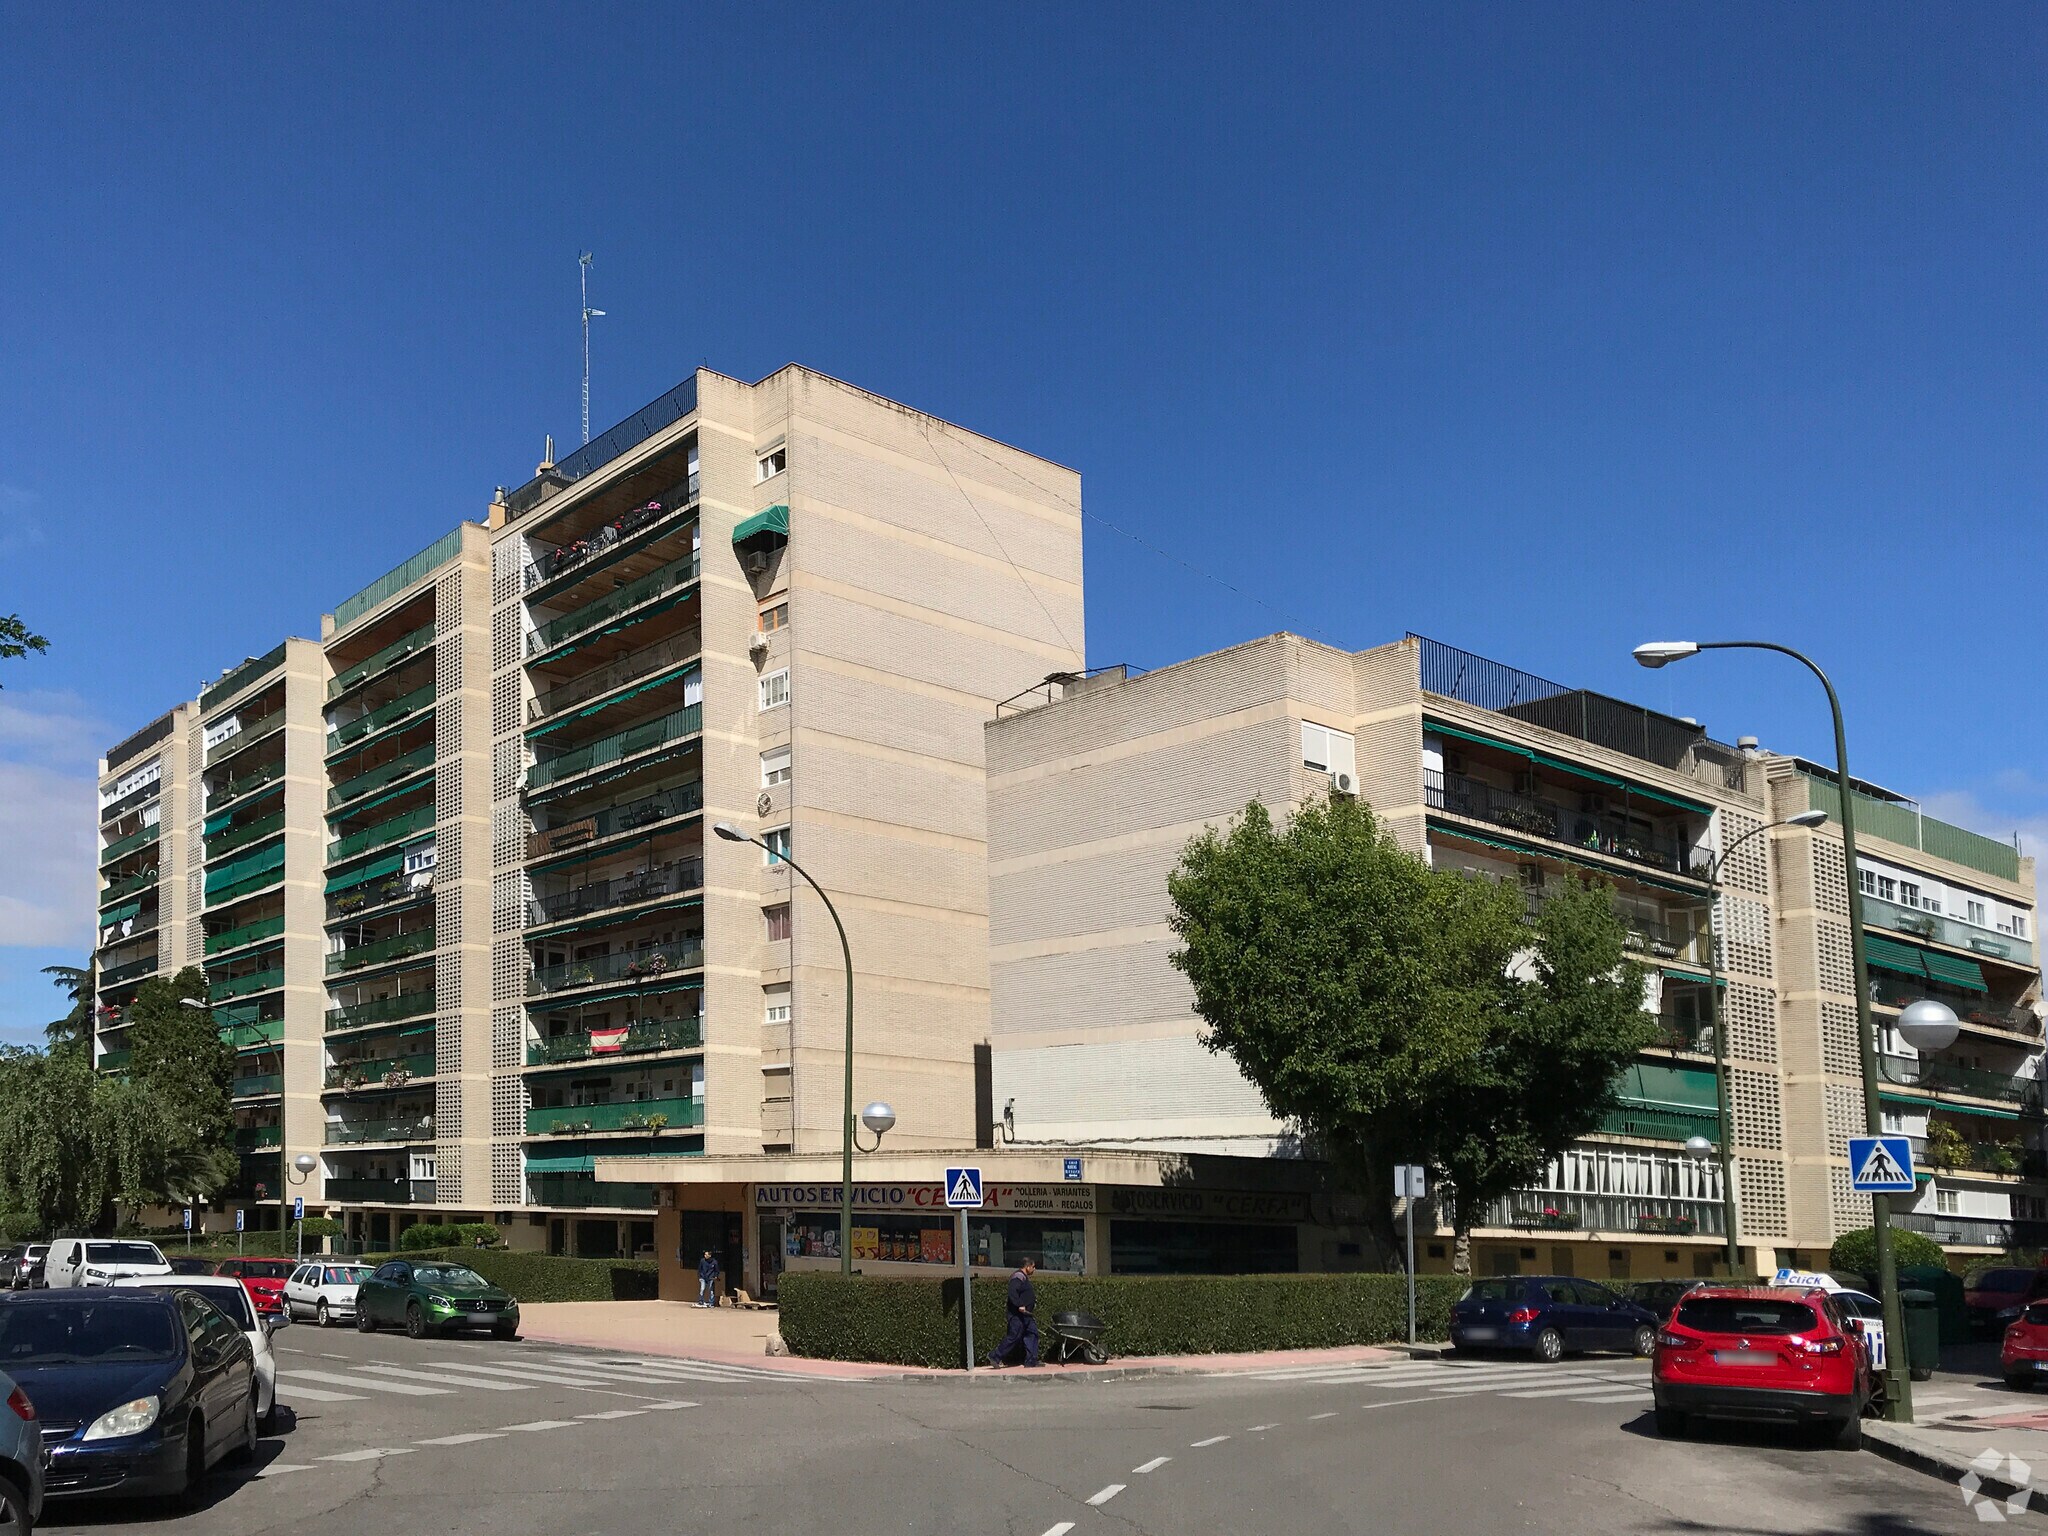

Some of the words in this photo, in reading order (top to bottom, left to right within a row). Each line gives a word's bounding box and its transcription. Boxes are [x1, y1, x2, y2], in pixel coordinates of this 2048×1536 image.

[757, 1187, 905, 1204] AUTOSERVICIO
[907, 1187, 1013, 1207] "CEA"
[1053, 1187, 1091, 1197] VARIANTES
[295, 1198, 302, 1217] P
[1014, 1199, 1053, 1209] DROGUERIA
[1061, 1200, 1094, 1210] REGALOS
[1779, 1270, 1786, 1279] L
